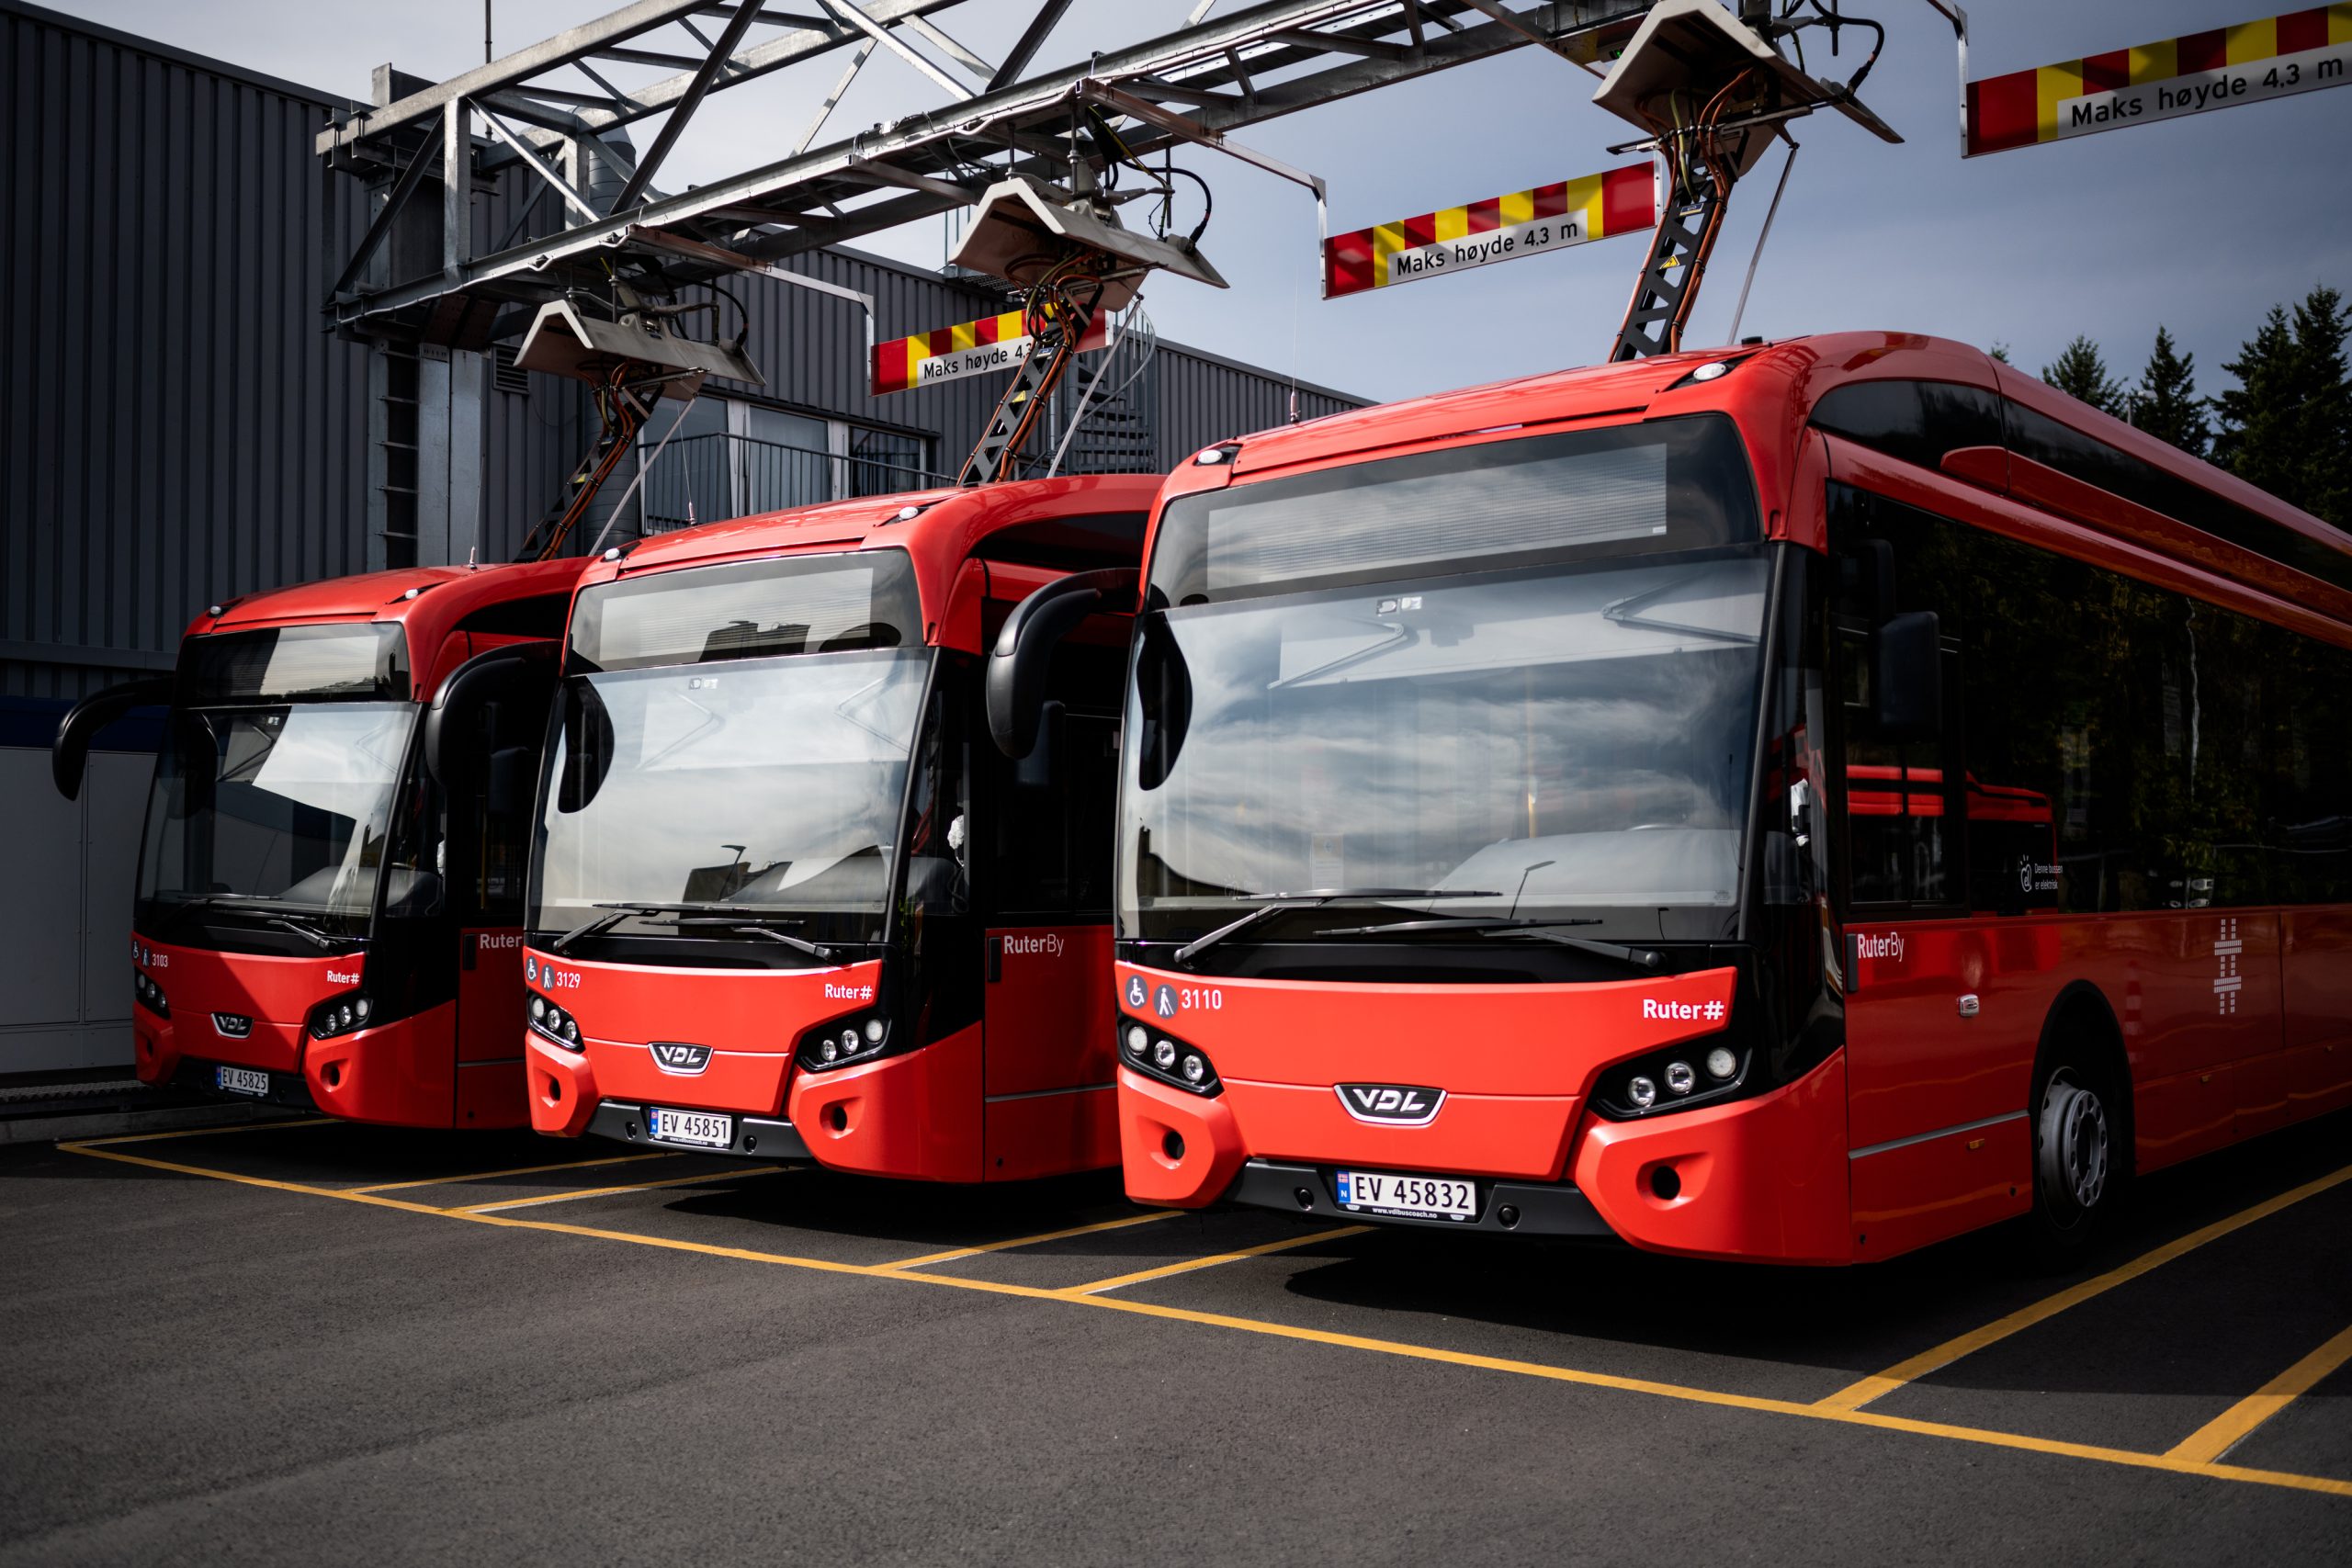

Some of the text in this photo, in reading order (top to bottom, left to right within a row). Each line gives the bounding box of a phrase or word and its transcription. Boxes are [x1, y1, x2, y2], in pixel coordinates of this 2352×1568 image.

[2071, 96, 2143, 128] Maks
[2158, 74, 2247, 109] høyde
[2318, 58, 2343, 80] m
[1396, 250, 1445, 276] Maks
[1454, 233, 1515, 262] høyde
[1560, 222, 1577, 240] m
[923, 358, 959, 379] Maks
[966, 347, 1008, 371] høyde
[2034, 863, 2064, 874] Denne bussen
[2035, 879, 2059, 890] er elektrisk
[1003, 933, 1065, 957] RuterBy
[1857, 931, 1905, 963] RuterBy
[152, 953, 168, 967] 3103
[556, 971, 581, 988] 3129
[1181, 987, 1223, 1010] 3110
[219, 1016, 247, 1030] VDL
[659, 1045, 702, 1063] VDL
[222, 1068, 267, 1090] EV 45825
[1352, 1089, 1426, 1112] VDL
[662, 1113, 727, 1139] EV 45851
[1340, 1190, 1348, 1198] N
[1355, 1176, 1470, 1210] EV 45832
